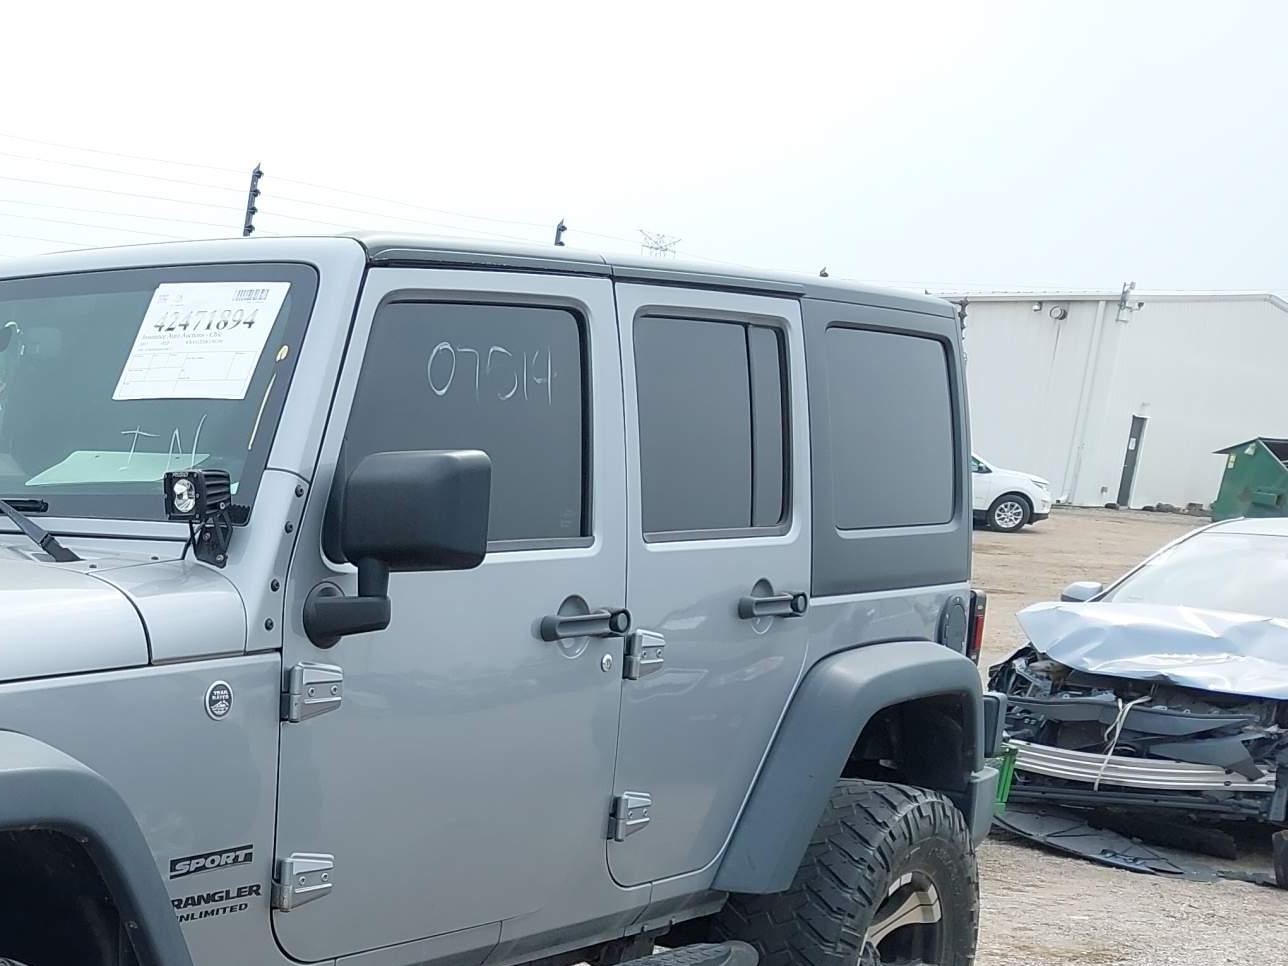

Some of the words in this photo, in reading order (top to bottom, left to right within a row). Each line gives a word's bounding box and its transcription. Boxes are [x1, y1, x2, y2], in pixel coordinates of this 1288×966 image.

[153, 308, 259, 332] 42471894
[171, 849, 253, 876] SPORT
[171, 884, 262, 910] RANGLER
[176, 902, 249, 922] NLIMITED
